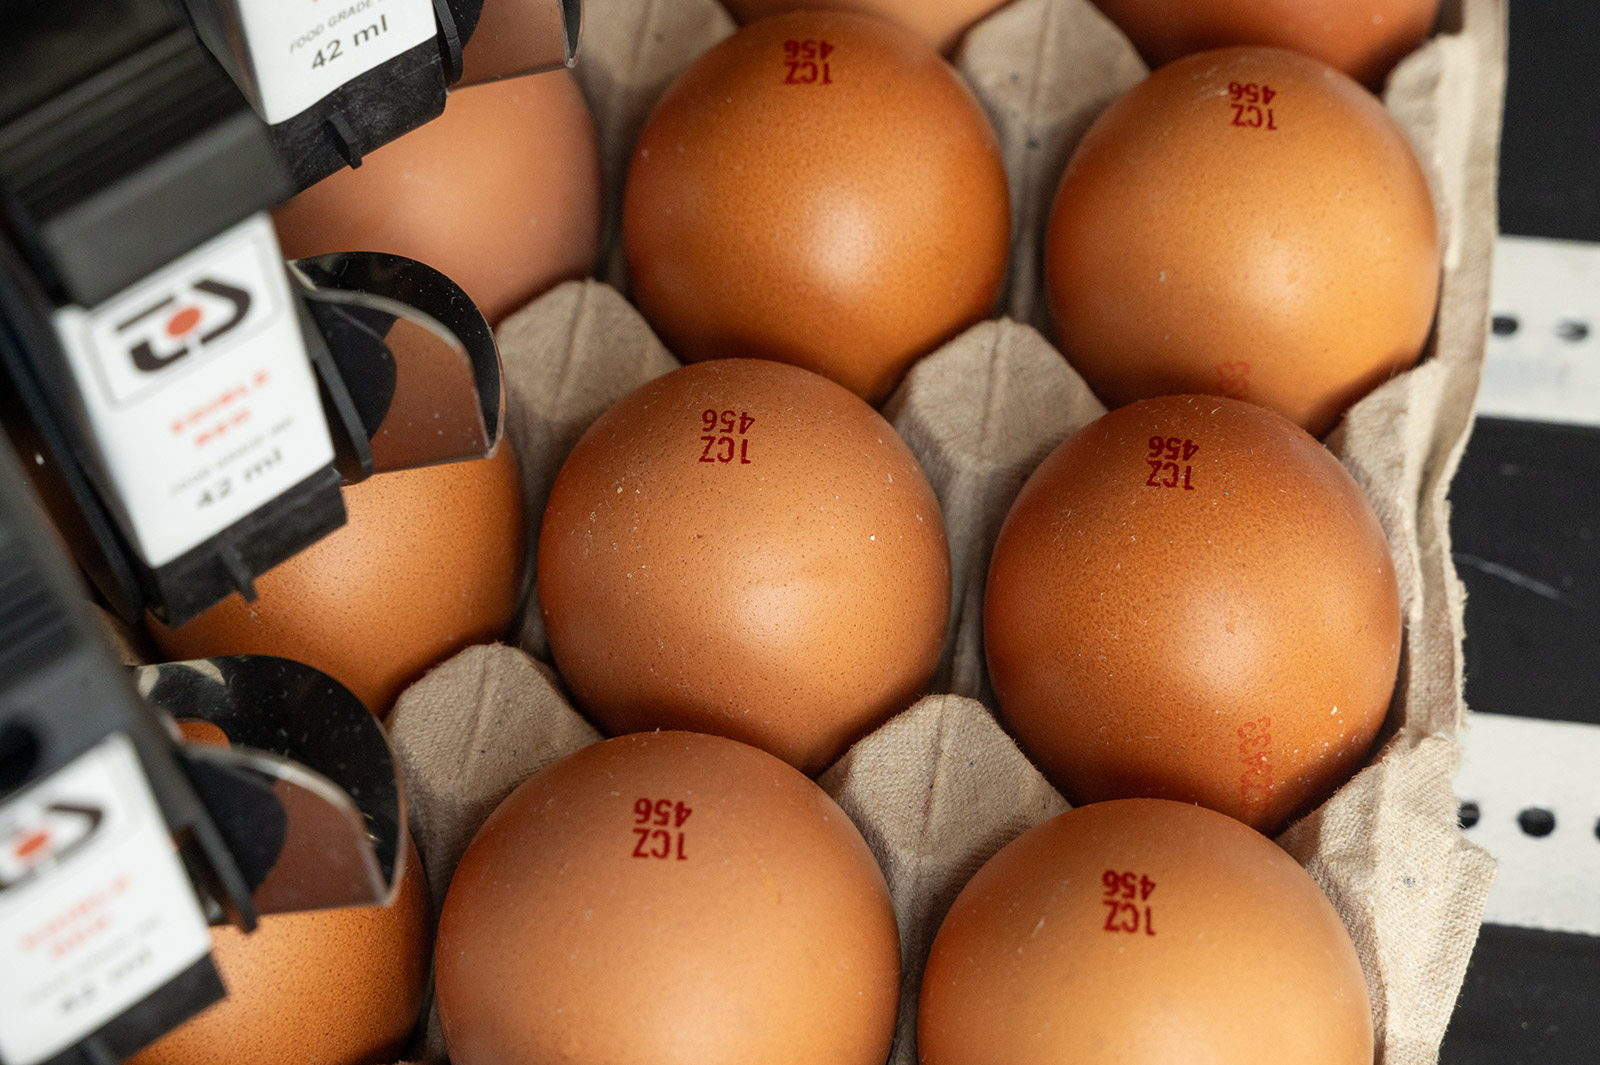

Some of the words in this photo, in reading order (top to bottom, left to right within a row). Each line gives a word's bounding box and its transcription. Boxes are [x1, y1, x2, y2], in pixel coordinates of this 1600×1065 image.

[289, 23, 325, 53] FOOD
[311, 39, 344, 69] 42
[353, 13, 388, 46] ml
[784, 39, 835, 60] 456
[783, 60, 834, 85] 1CZ
[1229, 82, 1277, 104] 456
[1230, 104, 1278, 130] 1CZ
[702, 408, 756, 435] 456
[699, 434, 752, 465] 1CZ
[1149, 435, 1200, 462] 456
[1146, 459, 1195, 490] 1CZ
[634, 797, 693, 828] 456
[632, 827, 688, 861] 1CZ
[1103, 869, 1156, 901] 456
[1104, 899, 1156, 937] 1CZ
